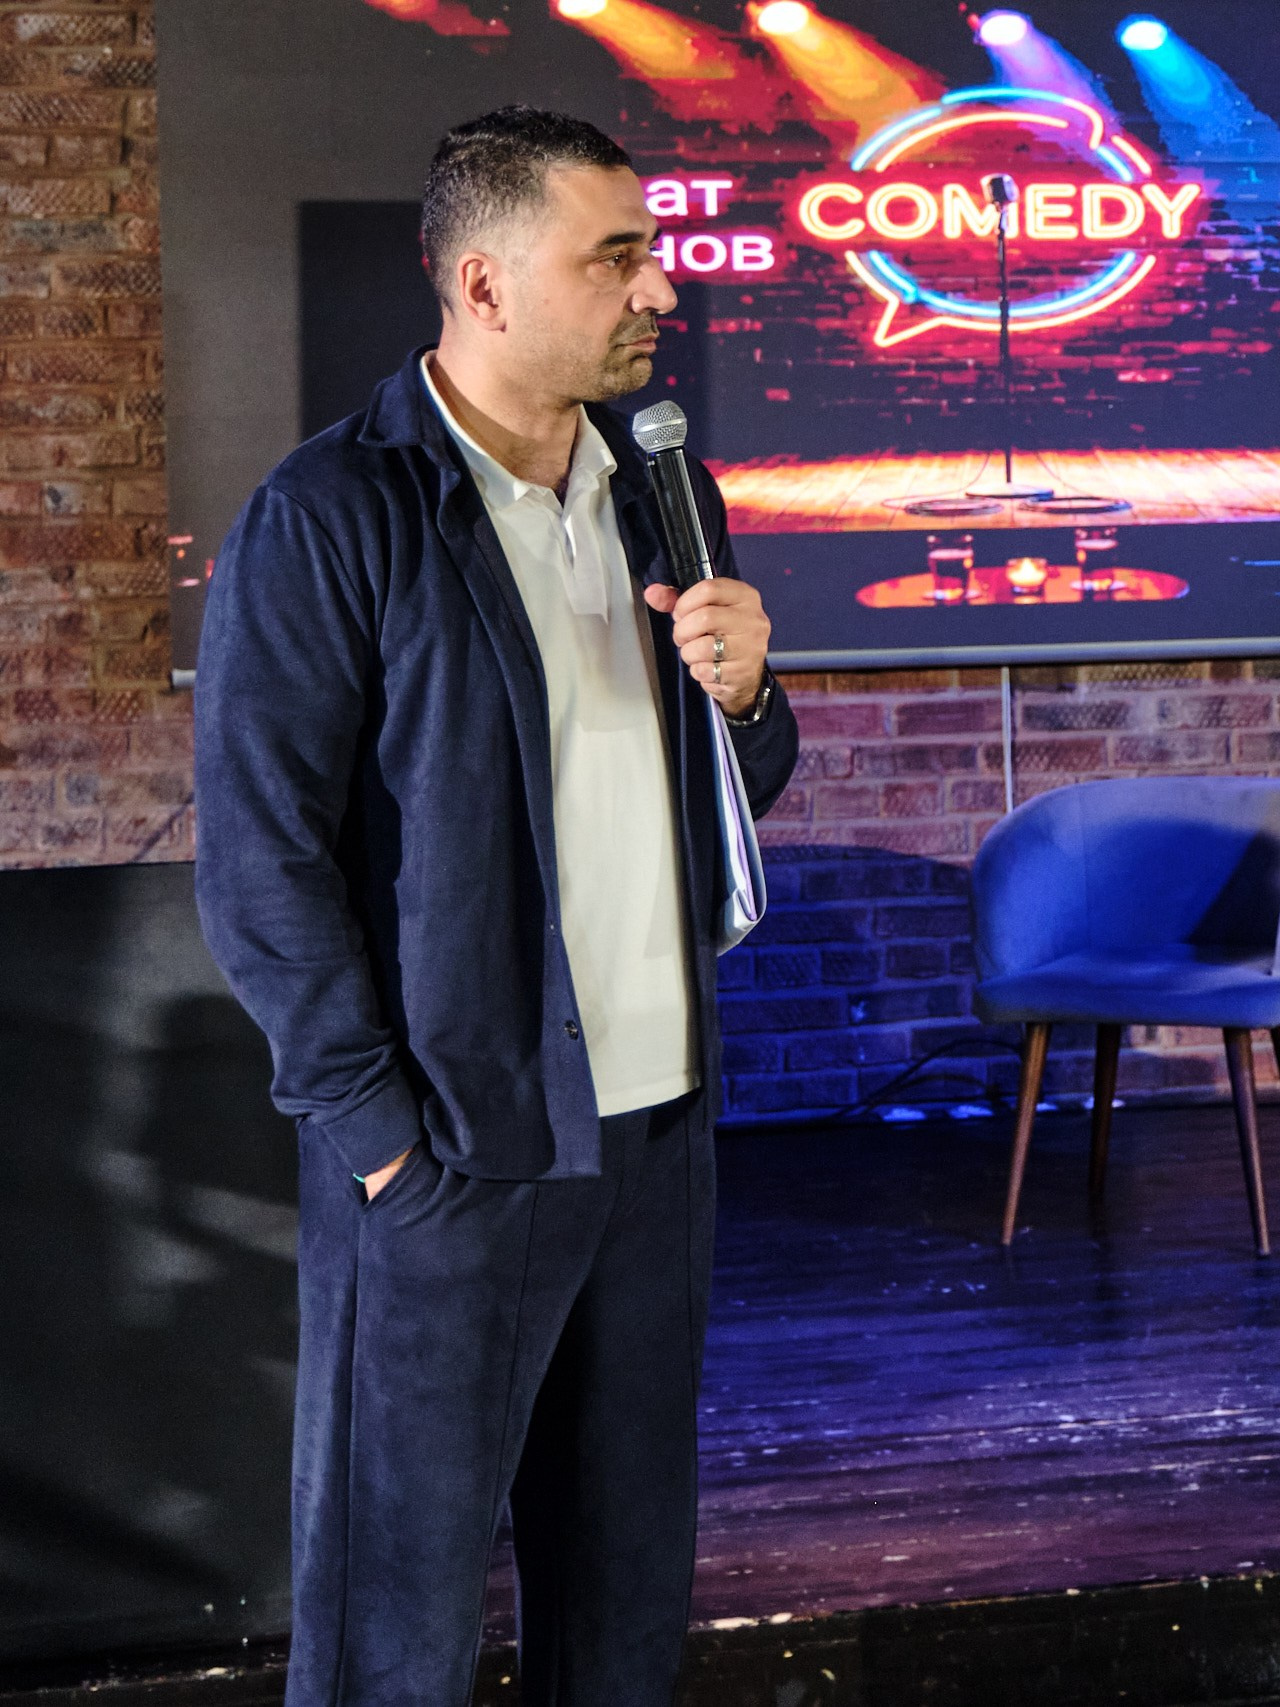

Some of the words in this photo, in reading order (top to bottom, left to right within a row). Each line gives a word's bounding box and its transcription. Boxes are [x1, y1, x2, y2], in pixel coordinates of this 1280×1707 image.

[645, 179, 733, 217] ат
[798, 182, 1200, 240] COMEDY
[650, 234, 775, 273] нов
